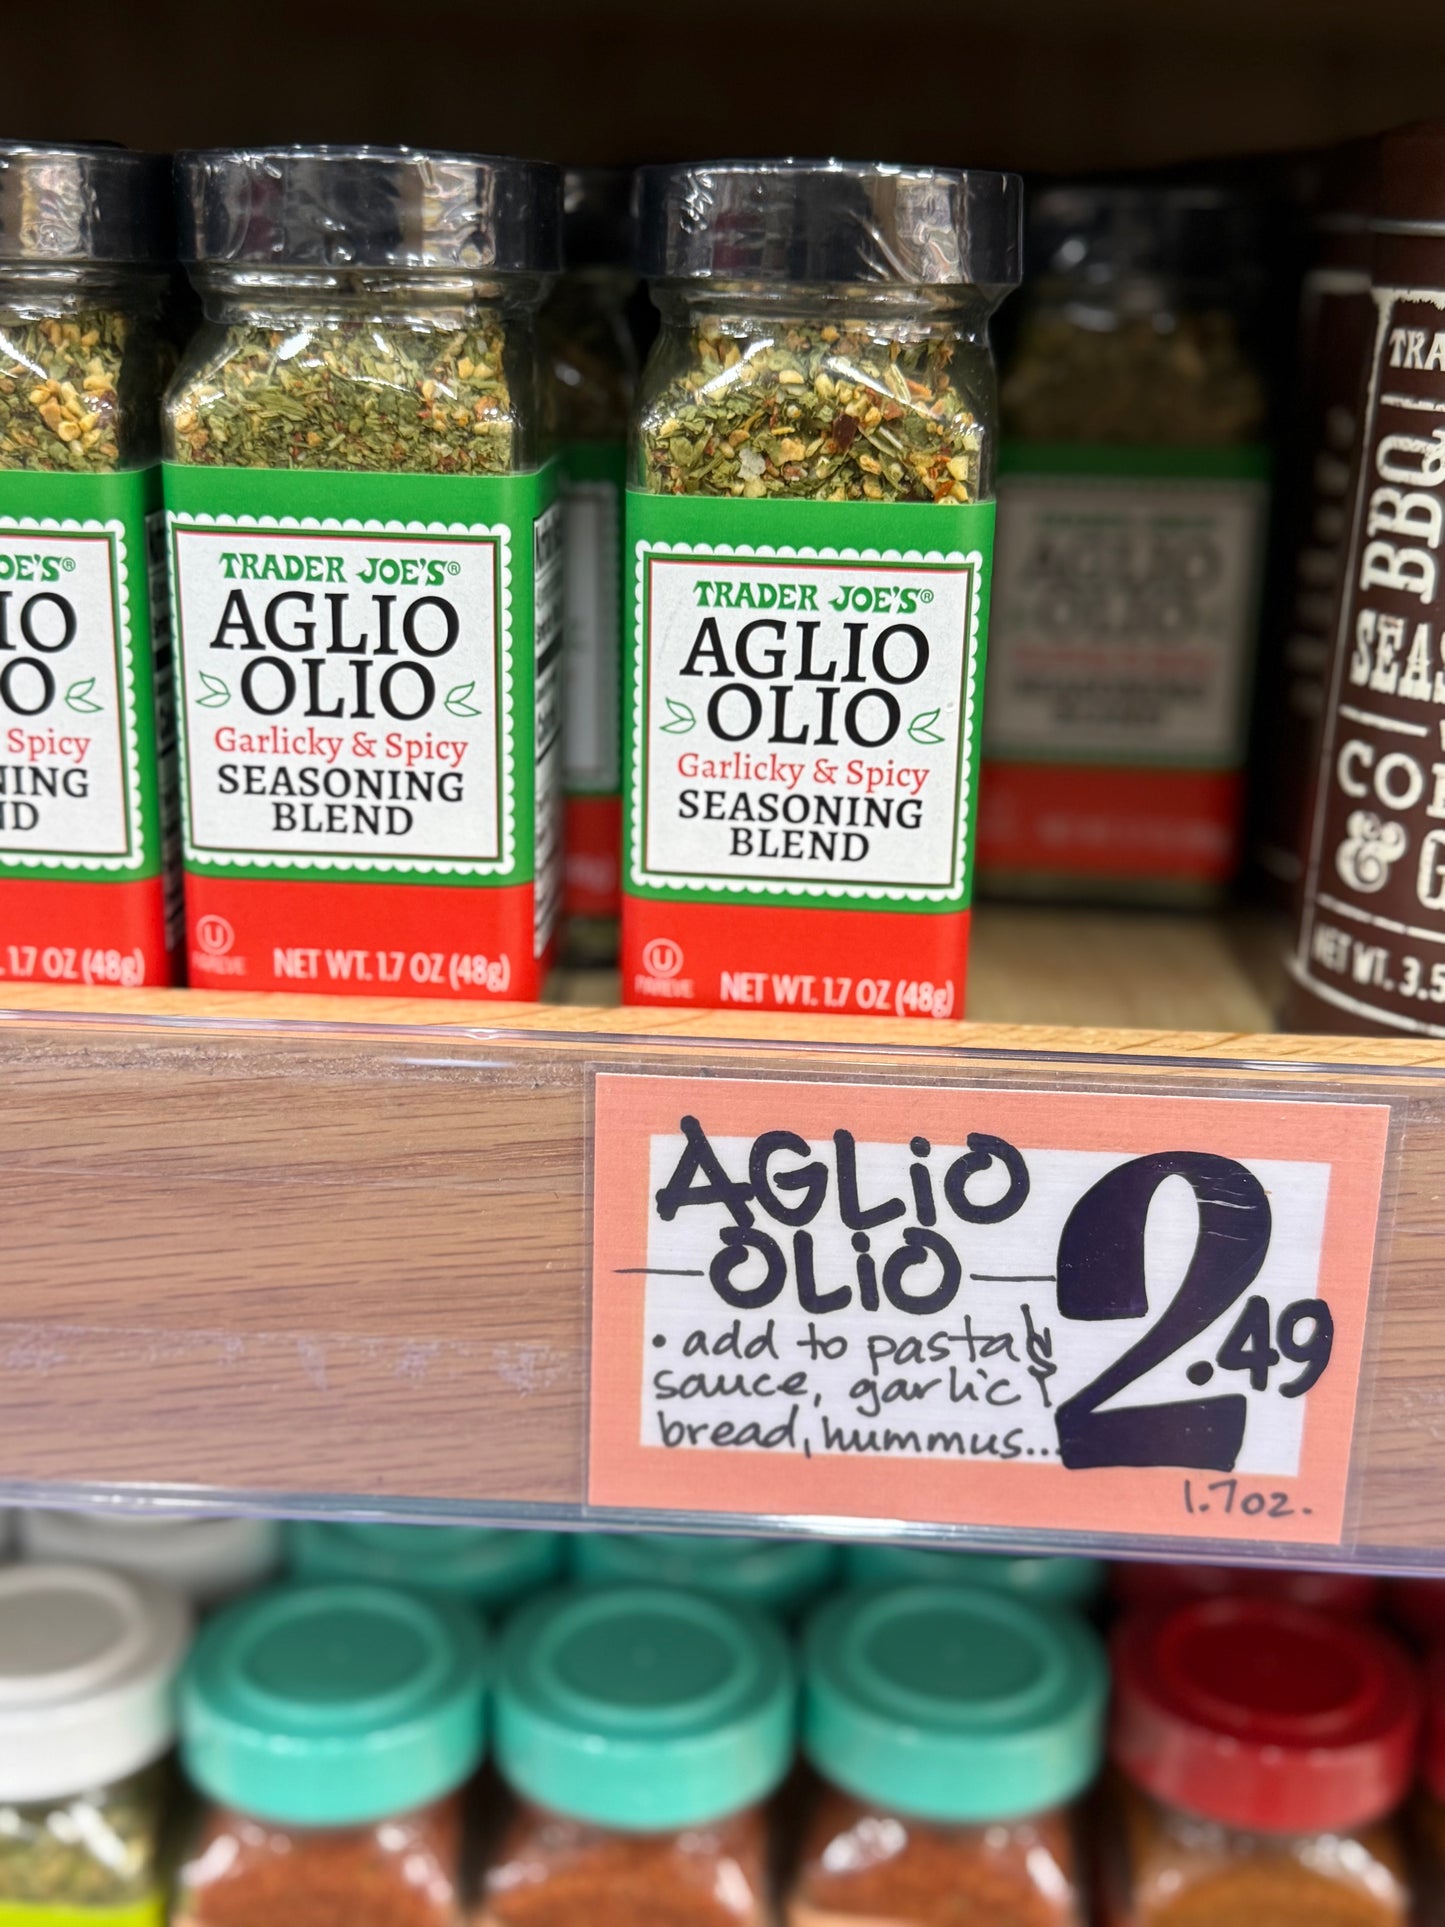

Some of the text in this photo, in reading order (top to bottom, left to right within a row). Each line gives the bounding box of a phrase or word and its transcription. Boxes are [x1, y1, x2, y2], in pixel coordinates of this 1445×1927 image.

[1388, 328, 1445, 372] TRA
[0, 554, 76, 582] OE'S®
[219, 552, 347, 583] TRADER
[693, 580, 819, 611] TRADER
[0, 591, 77, 653] IO
[210, 588, 460, 657] AGLIO
[679, 616, 930, 685] AGLIO
[240, 655, 436, 720] OLIO
[707, 683, 901, 748] OLIO
[7, 728, 92, 764] Spicy
[214, 727, 469, 767] Garlicky & Spicy
[218, 764, 464, 802] SEASONING
[677, 753, 930, 794] Garlicky & Spicy
[272, 802, 413, 836] BLEND
[678, 790, 923, 829] SEASONING
[729, 827, 870, 862] BLEND
[1335, 810, 1406, 893] &
[42, 946, 79, 979] OZ
[82, 947, 145, 987] (48g)
[273, 948, 321, 980] NET
[325, 949, 373, 981] WT.
[409, 952, 445, 983] OZ
[449, 953, 510, 992] (48g)
[1399, 956, 1445, 1004] 3.5
[720, 971, 768, 1003] NET
[772, 974, 818, 1006] WT.
[855, 978, 891, 1010] OZ
[895, 979, 954, 1018] (48g)
[1055, 1151, 1334, 1472] 2.49
[682, 1315, 1020, 1376] add to pasta
[653, 1365, 1022, 1416] sauce, garlic
[657, 1403, 812, 1458] bread,
